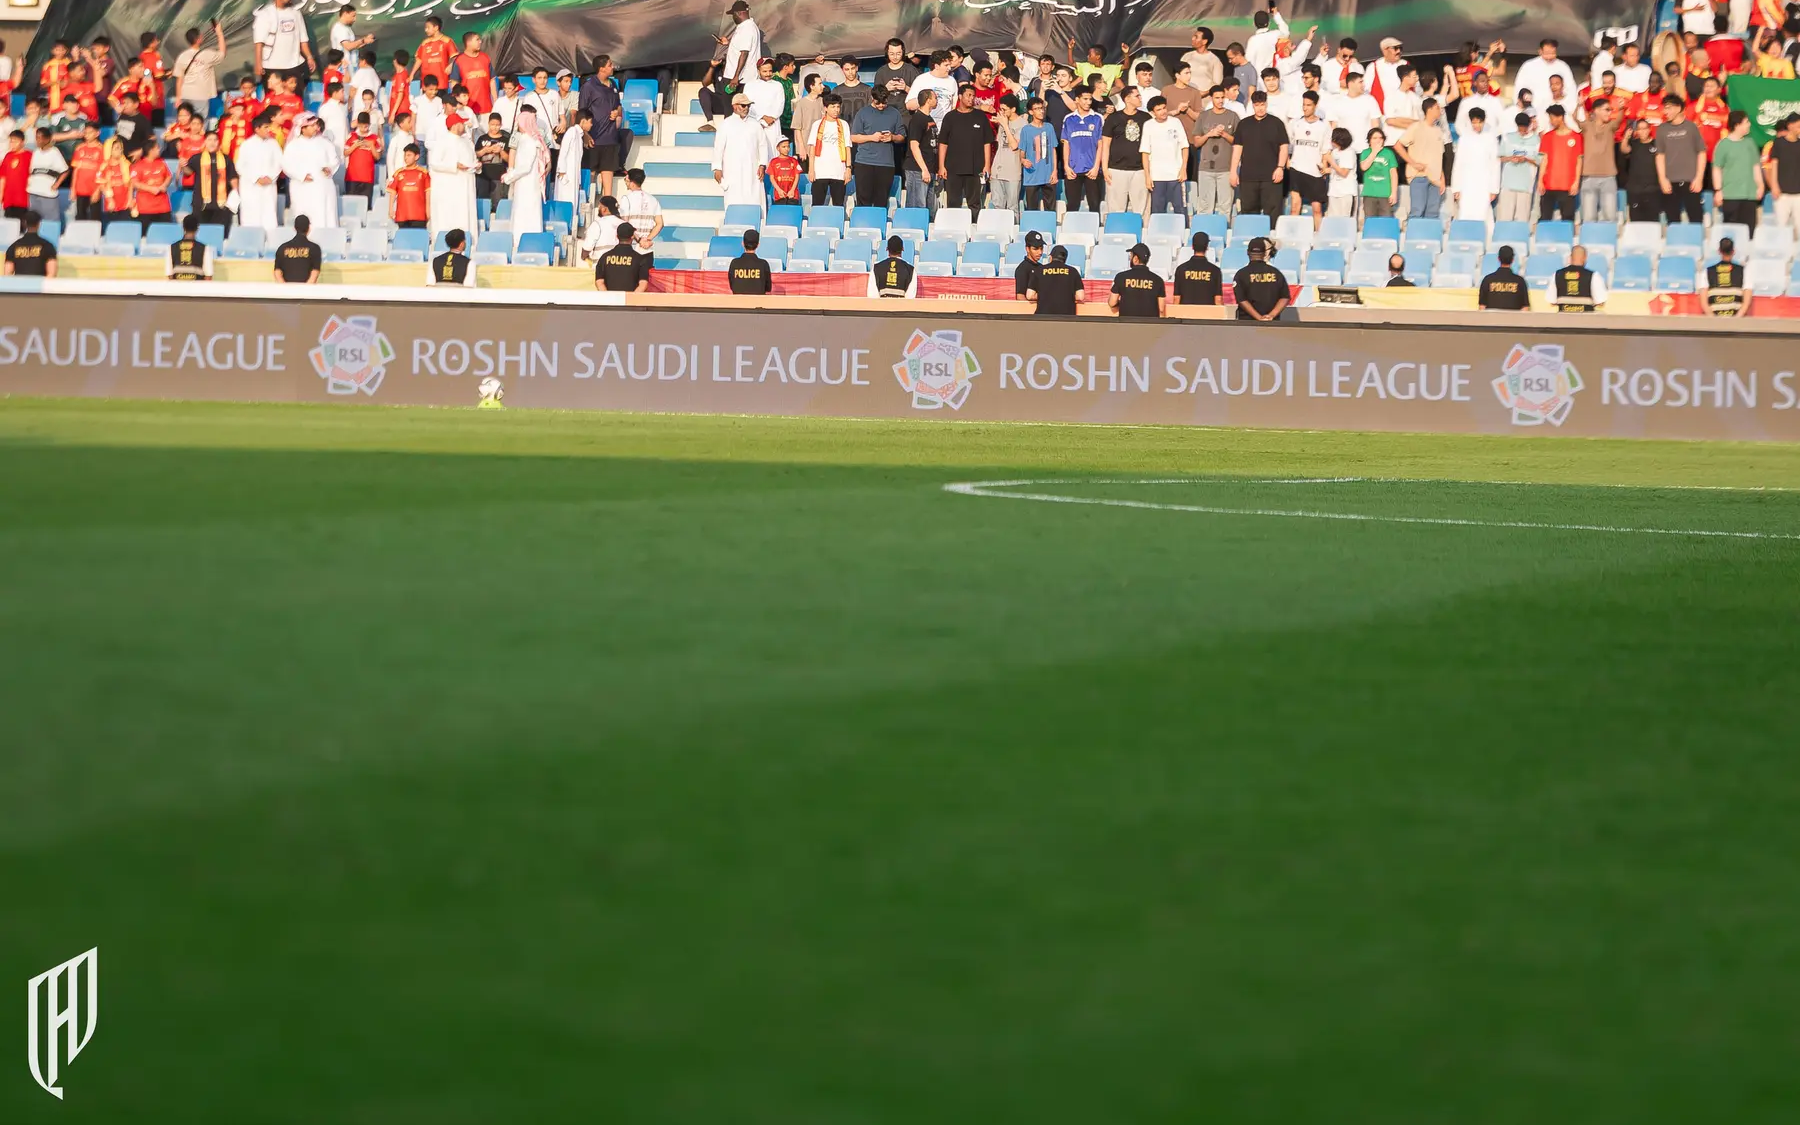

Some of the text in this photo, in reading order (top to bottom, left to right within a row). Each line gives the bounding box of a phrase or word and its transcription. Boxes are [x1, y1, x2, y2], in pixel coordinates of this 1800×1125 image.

[606, 254, 633, 266] POLICE
[733, 268, 761, 280] POLICE
[1042, 267, 1070, 276] POLICE
[1184, 270, 1211, 282] POLICE
[1249, 272, 1277, 283] POLICE
[1126, 278, 1153, 290] POLICE
[1489, 281, 1518, 293] POLICE
[0, 327, 286, 371] SAUDI LEAGUE
[338, 347, 366, 363] RSL
[412, 339, 870, 386] ROSHN SAUDI LEAGUE
[923, 362, 952, 377] RSL
[1000, 352, 1472, 401] ROSHN SAUDI LEAGUE
[1523, 377, 1553, 392] RSL
[1602, 367, 1757, 409] ROSHN
